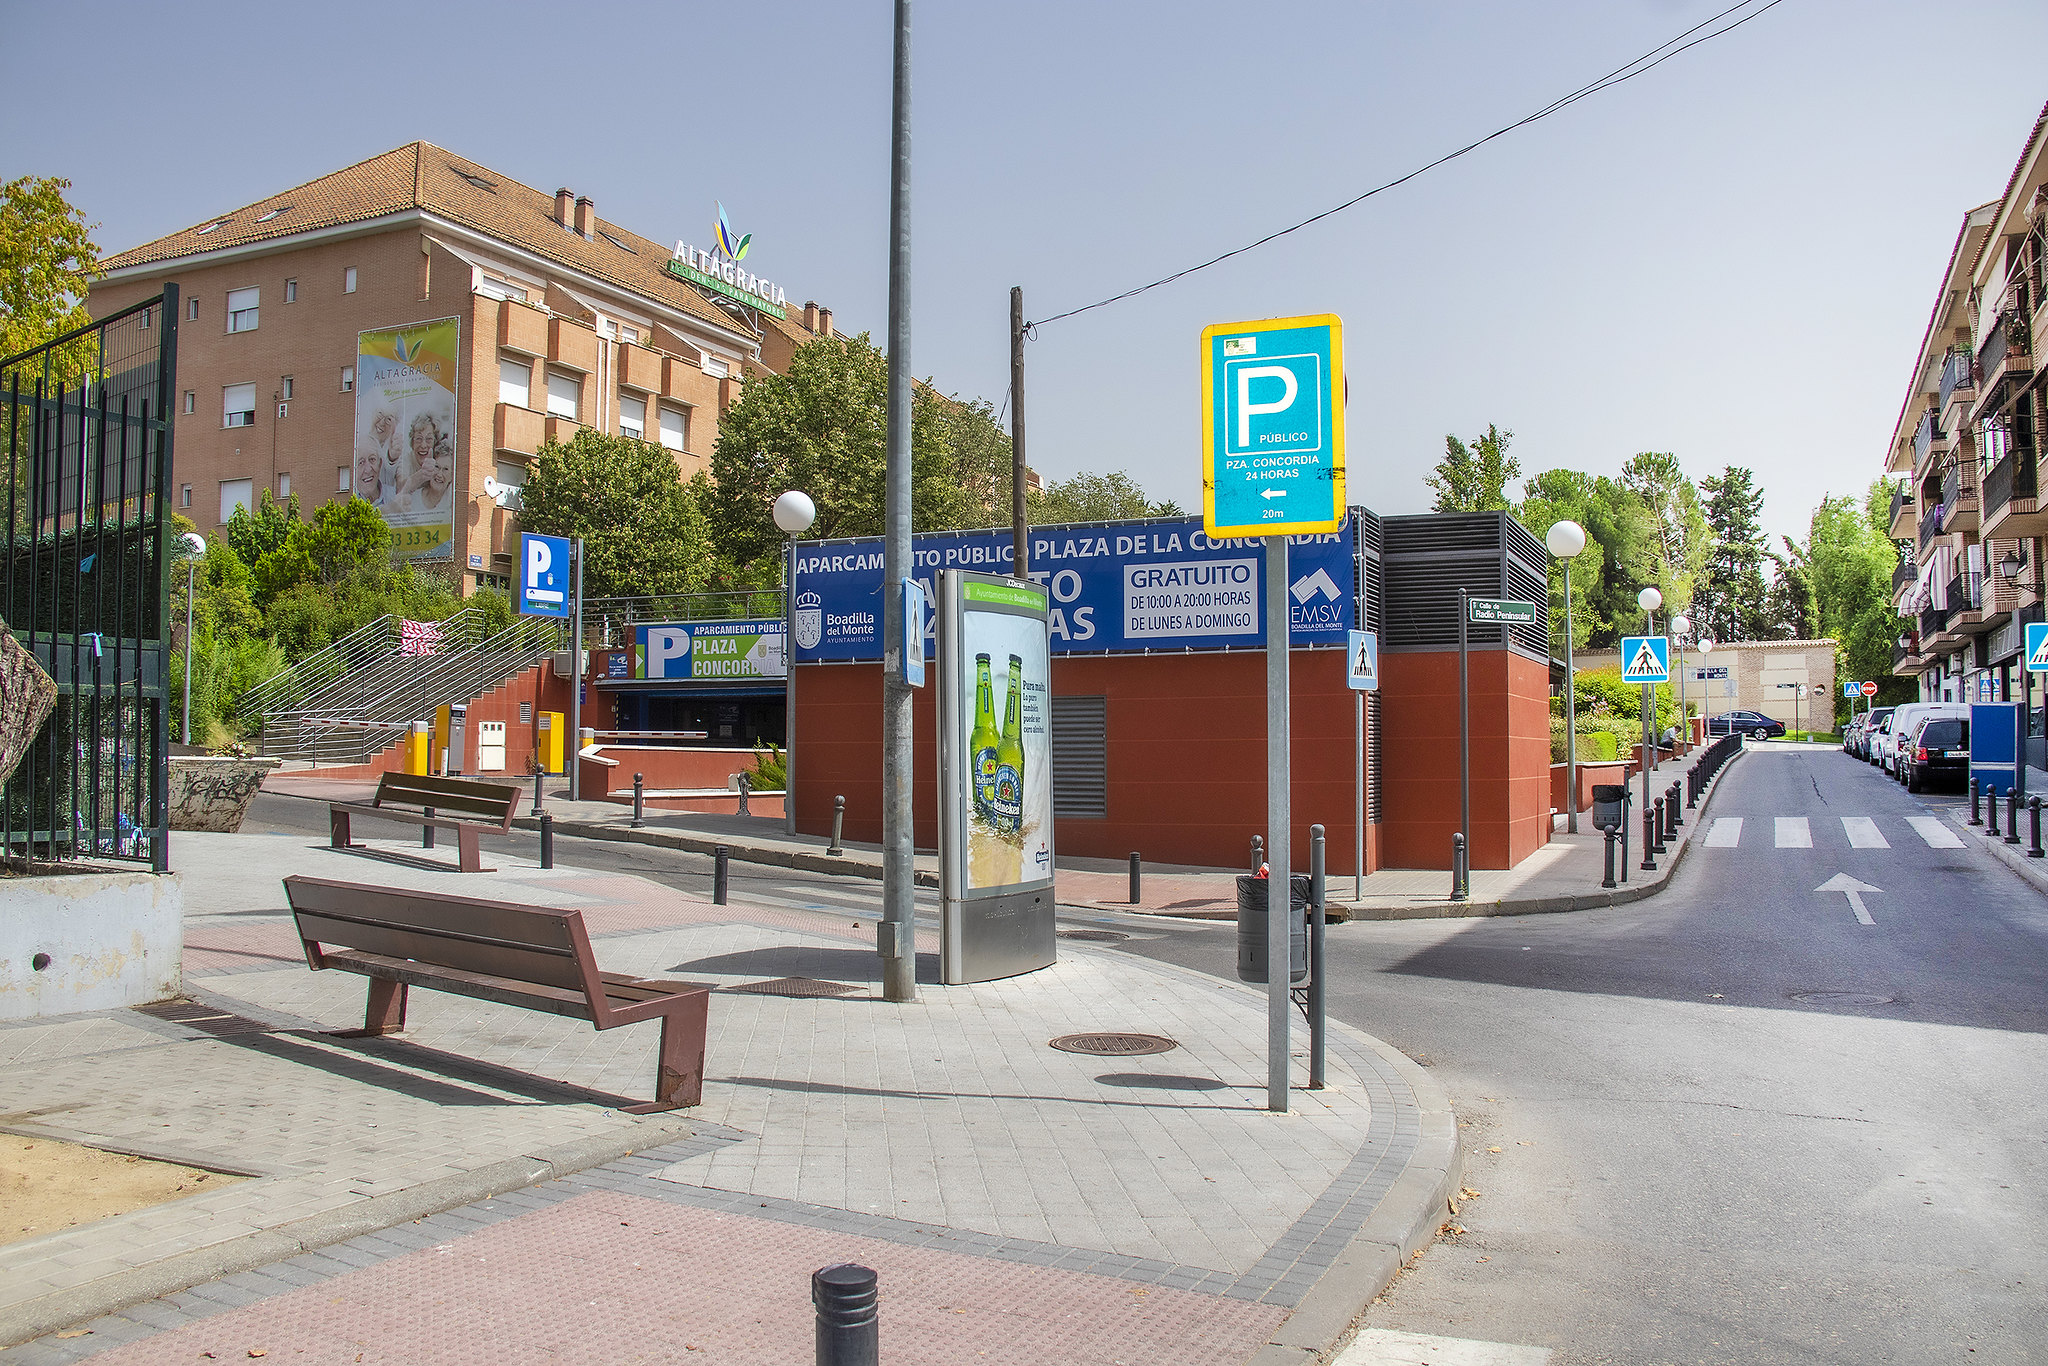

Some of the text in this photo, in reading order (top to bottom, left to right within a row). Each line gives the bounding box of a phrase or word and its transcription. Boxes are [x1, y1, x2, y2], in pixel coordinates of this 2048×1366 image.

[672, 239, 787, 309] ALTAGRACIA
[728, 287, 749, 303] PARA
[751, 297, 785, 320] MAYORES
[374, 362, 441, 381] ALTAGRACIA
[1237, 365, 1298, 448] P
[1259, 431, 1308, 443] PÚBLICO
[1226, 455, 1320, 470] PZA. CONCORDIA
[1245, 468, 1299, 480] 24 HORAS
[1262, 509, 1284, 519] 20m
[406, 531, 420, 546] 33
[424, 529, 440, 545] 34
[945, 544, 1029, 566] PÚBLIC
[1034, 536, 1110, 561] PLAZA
[1116, 534, 1147, 556] DE
[1153, 533, 1183, 553] LA
[527, 539, 552, 588] P
[1130, 564, 1251, 588] GRATUITO
[976, 588, 1008, 601] Ayuntamiento
[1014, 593, 1030, 605] Boadilla
[1131, 591, 1251, 609] DE 10:00 A 20:00 HORAS
[1291, 604, 1342, 623] EMSV
[1479, 602, 1492, 610] Calle
[827, 612, 874, 626] Boadilla
[1131, 612, 1251, 631] DE LUNES A DOMINGO
[1475, 610, 1532, 621] Radio Peninsular
[694, 622, 788, 635] APARCAMIENTO PÚBLIC
[827, 625, 874, 636] del Monte
[693, 638, 738, 655] PLAZA
[826, 636, 875, 644] AYUNTAMIENTO
[647, 627, 691, 679] P
[693, 659, 776, 676] CONCORDIA
